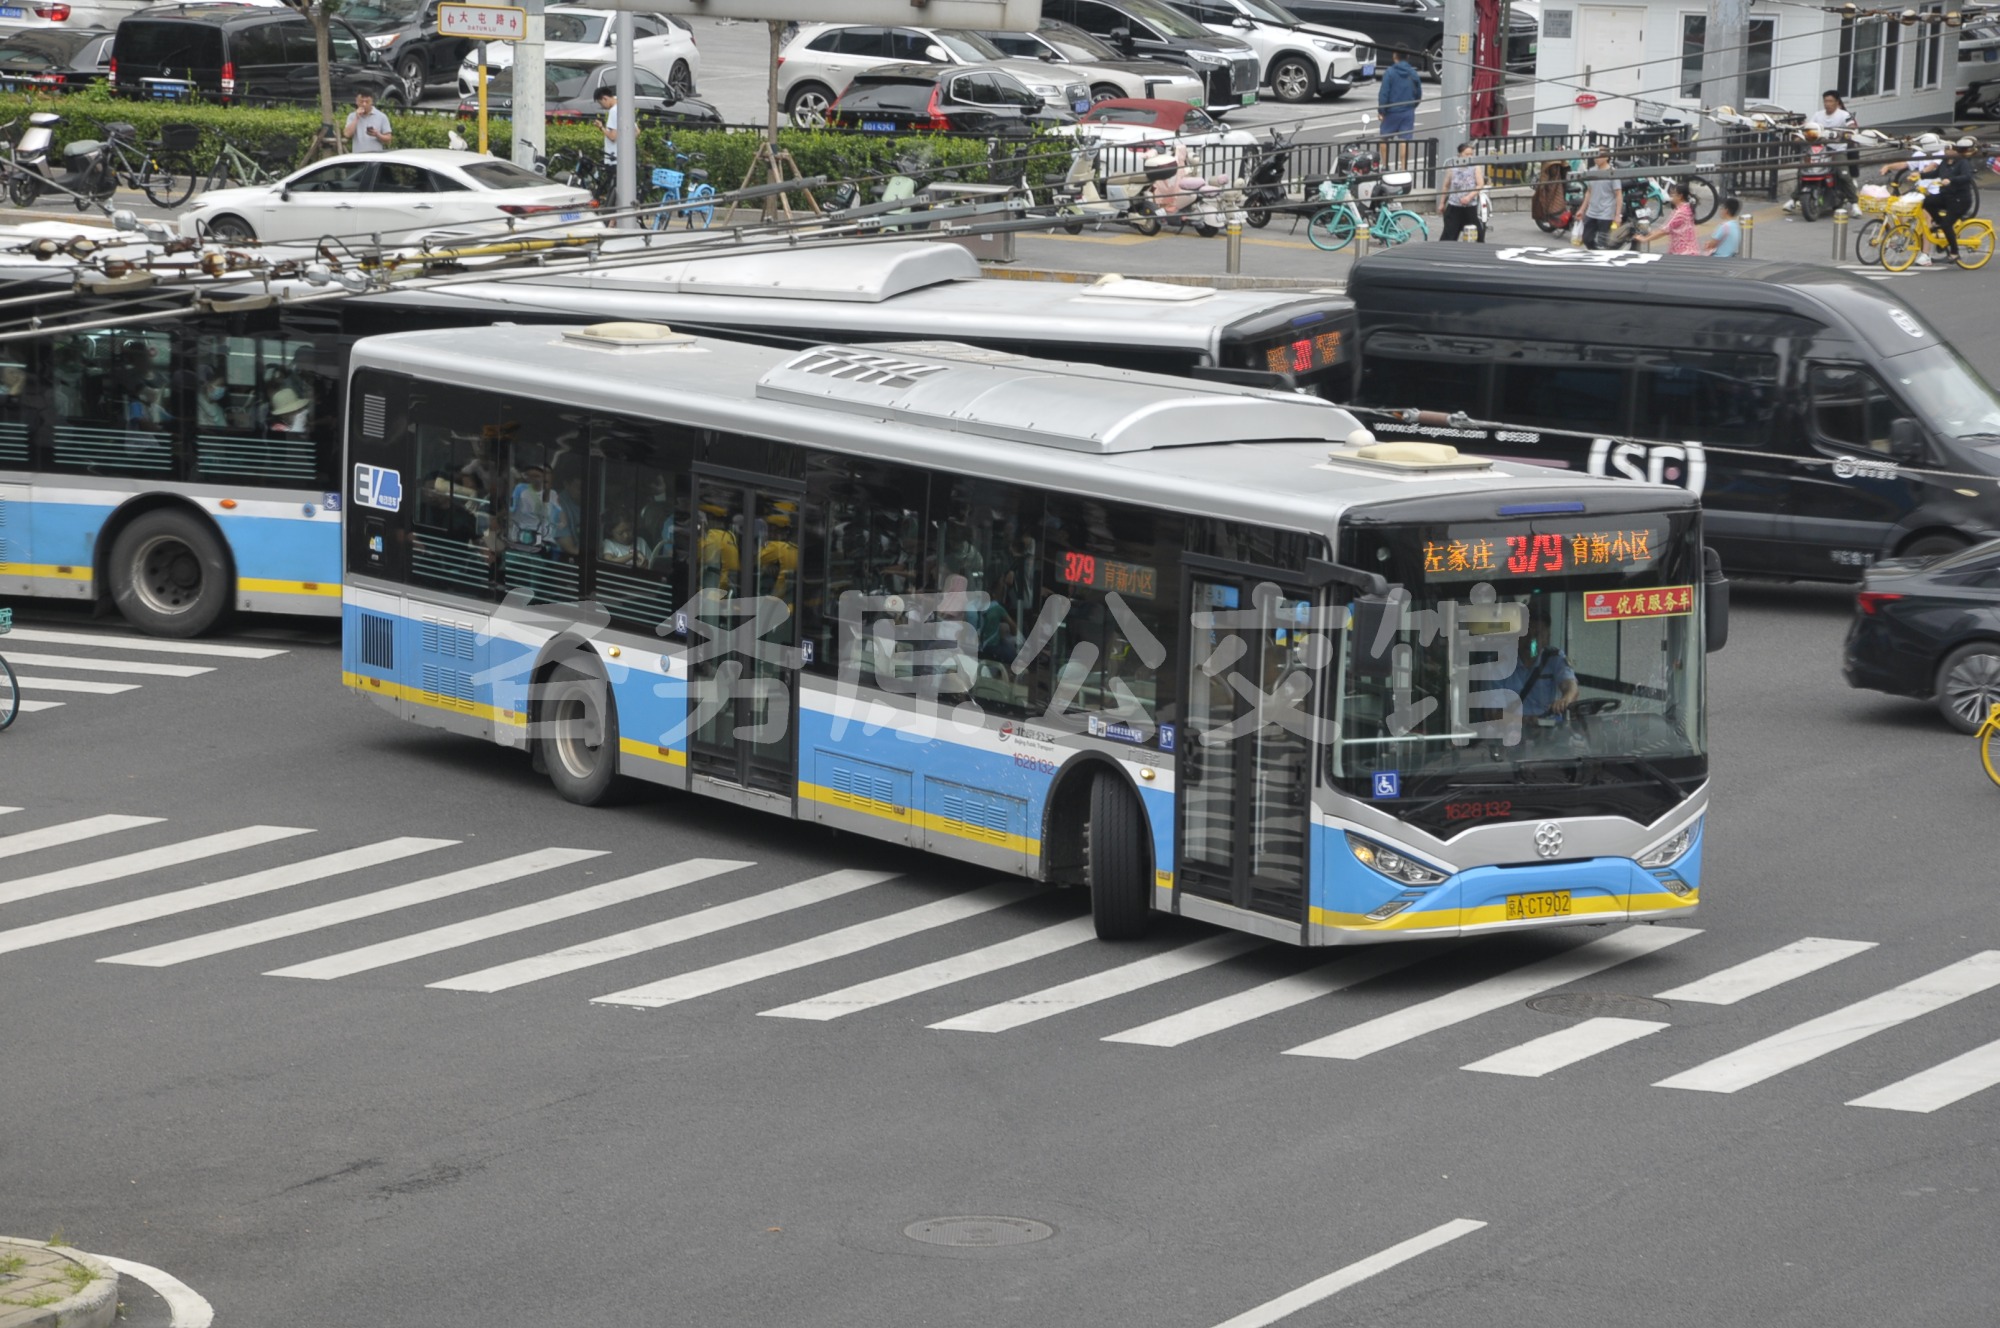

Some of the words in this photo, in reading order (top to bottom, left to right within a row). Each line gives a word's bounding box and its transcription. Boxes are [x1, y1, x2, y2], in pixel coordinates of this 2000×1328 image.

[459, 11, 504, 25] 大屯路
[1423, 537, 1496, 573] 左家庄
[1571, 529, 1651, 566] 育新小区
[1065, 551, 1096, 585] 379
[1104, 559, 1153, 596] 育新小区
[1616, 590, 1690, 615] 优质服务车
[1016, 726, 1055, 744] 北京公交
[1013, 752, 1055, 776] 1628132
[1444, 801, 1511, 819] 1628132
